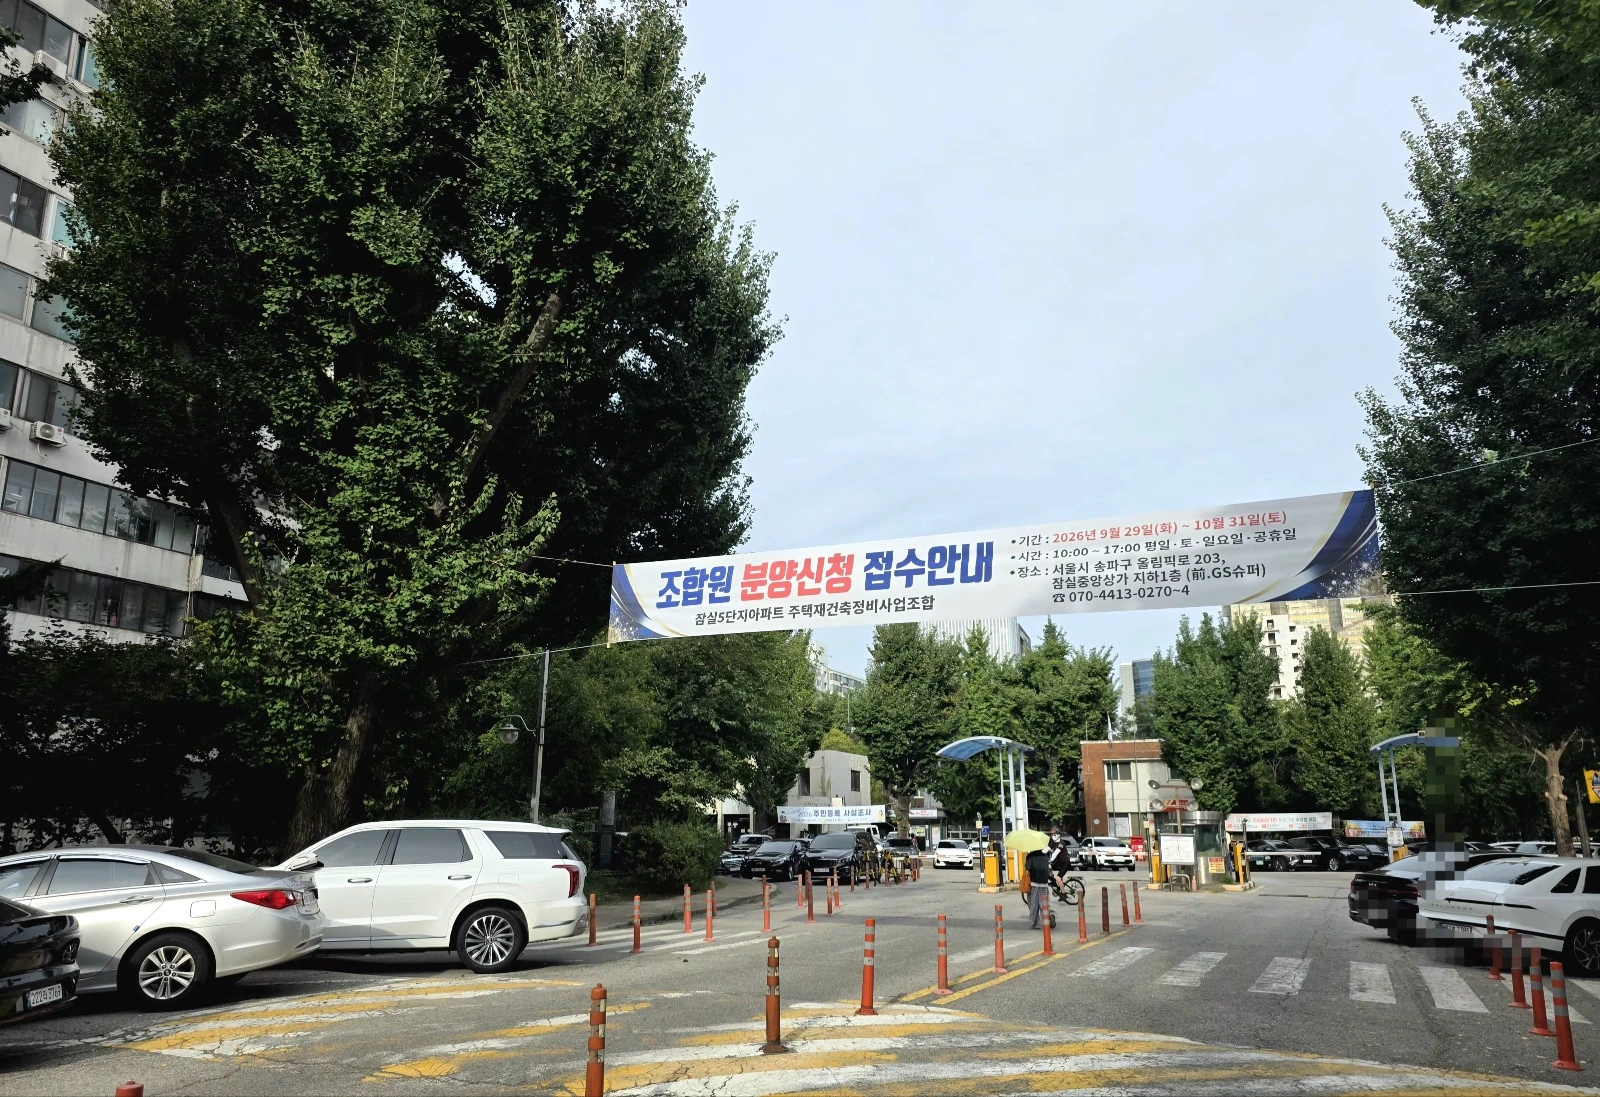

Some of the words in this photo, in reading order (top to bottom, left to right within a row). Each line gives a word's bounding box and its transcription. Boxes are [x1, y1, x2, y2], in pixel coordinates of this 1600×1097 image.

[1018, 534, 1042, 546] 기간
[1052, 529, 1096, 543] 2026년
[1100, 526, 1120, 539] 9월
[1124, 521, 1178, 537] 29일(화)
[1194, 516, 1225, 531] 10월
[1229, 511, 1287, 527] 31일(토)
[1018, 550, 1042, 561] 시간
[1052, 547, 1088, 559] 10:00
[1103, 543, 1140, 554] 17:00
[1253, 528, 1297, 543] 공휴일
[656, 565, 734, 609] 조합원
[740, 552, 855, 601] 분양신청
[863, 541, 994, 591] 접수안내
[1017, 565, 1041, 578] 장소
[1052, 561, 1089, 576] 서울시
[1093, 559, 1132, 573] 송파구
[1136, 554, 1190, 570] 올림픽로
[1194, 552, 1226, 565] 203,
[1052, 572, 1128, 590] 잠실중앙상가
[1133, 569, 1182, 584] 지하1층
[1186, 563, 1266, 582] (前.GS슈퍼)
[1069, 585, 1190, 602] 070-4413-0270~4
[694, 606, 785, 626] 잠실5단지아파트
[788, 595, 936, 619] 주택재건축정비사업조합
[813, 809, 841, 818] 주민등록
[844, 808, 871, 817] 사실조사
